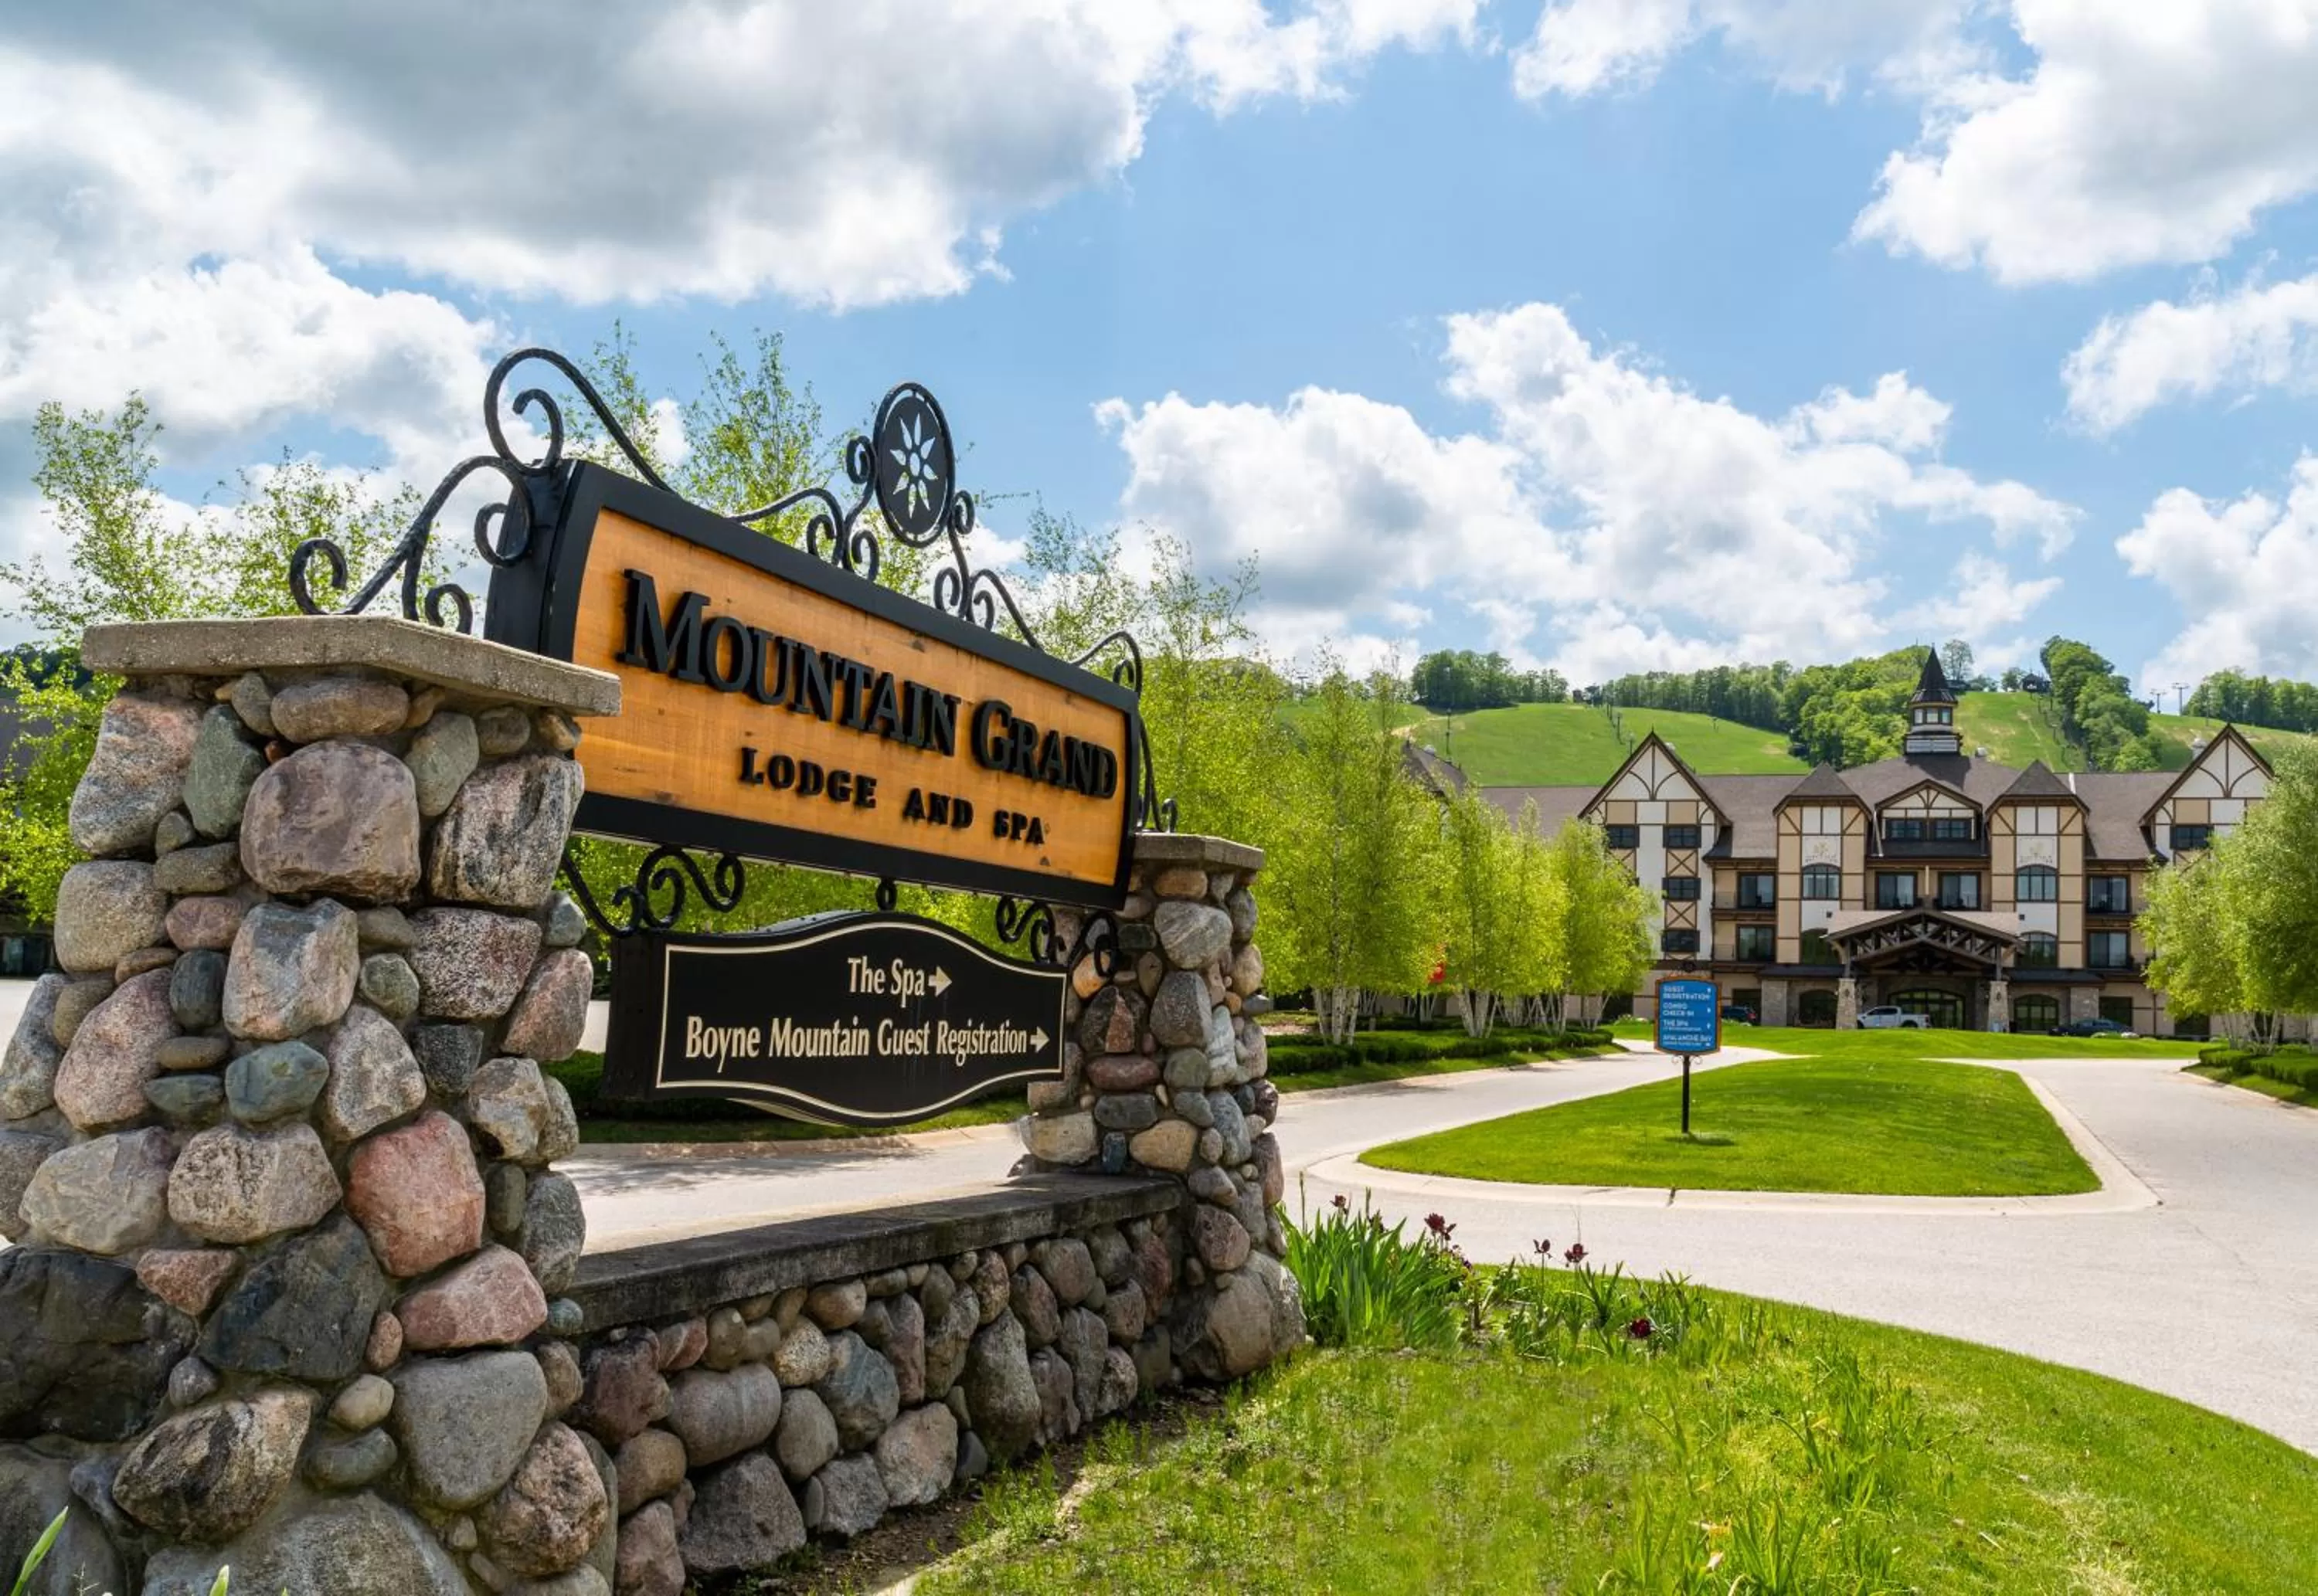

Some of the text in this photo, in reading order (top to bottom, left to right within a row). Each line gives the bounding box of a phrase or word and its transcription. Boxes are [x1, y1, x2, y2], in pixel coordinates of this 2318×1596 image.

[617, 568, 1118, 800] MOUNTAIN GRAND
[739, 745, 1045, 845] LODGE AND SPA
[848, 955, 926, 1008] The Spa
[685, 1015, 1028, 1073] Boyne Mountain Guest Registration
